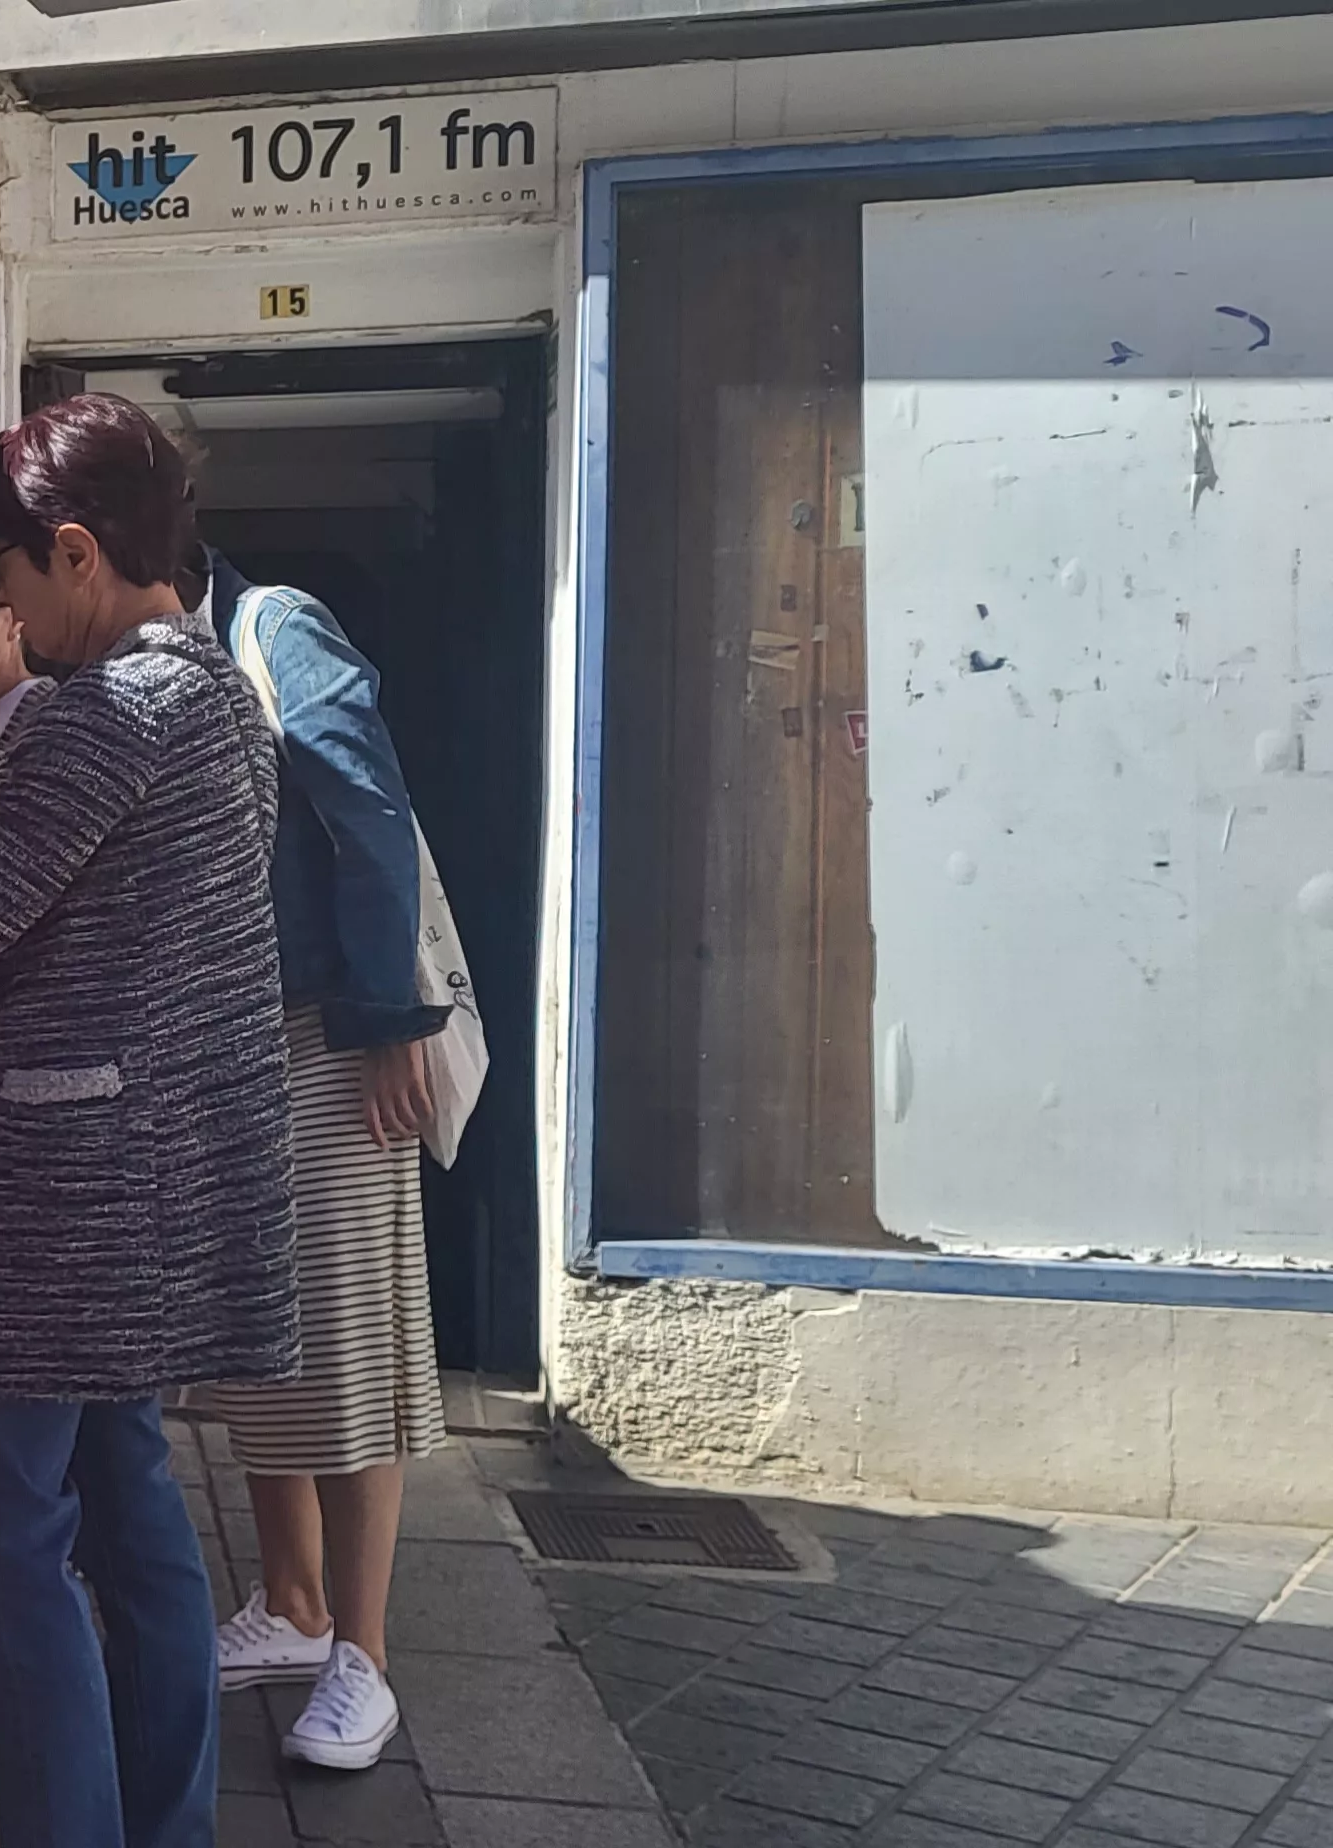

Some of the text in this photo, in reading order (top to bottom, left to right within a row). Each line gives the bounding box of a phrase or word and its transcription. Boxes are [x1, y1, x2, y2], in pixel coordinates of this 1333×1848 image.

[87, 131, 176, 190] hit
[231, 108, 535, 189] 107,1 fm
[73, 194, 190, 226] Huesca
[231, 186, 539, 219] www.hithuesca.com
[265, 287, 307, 317] 15
